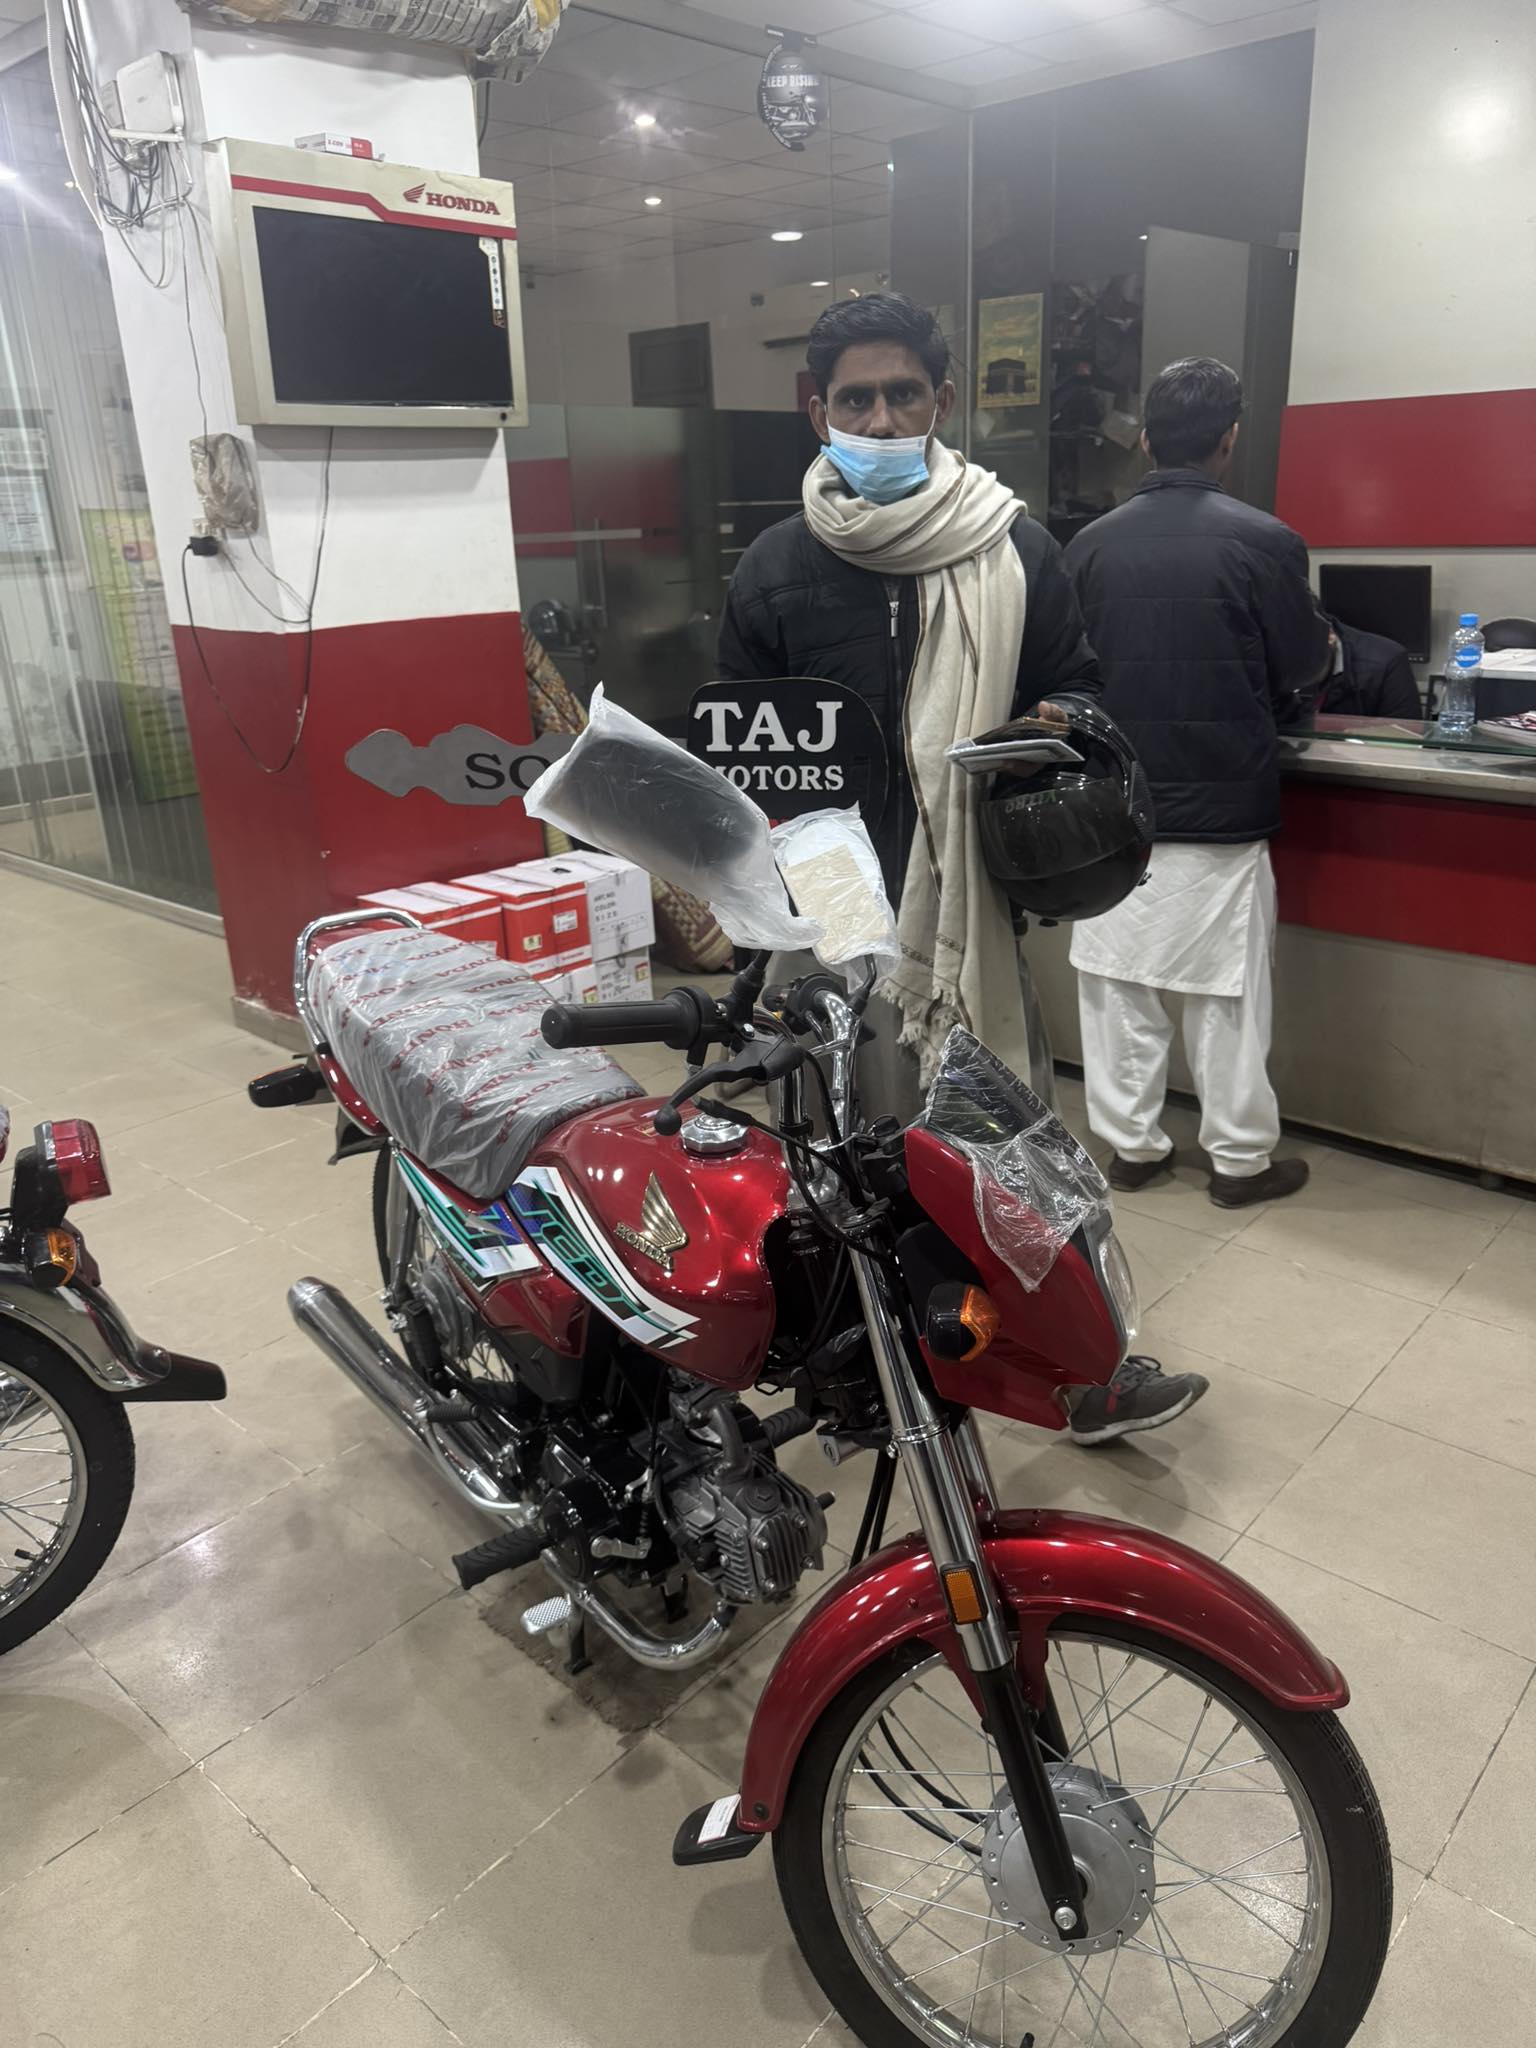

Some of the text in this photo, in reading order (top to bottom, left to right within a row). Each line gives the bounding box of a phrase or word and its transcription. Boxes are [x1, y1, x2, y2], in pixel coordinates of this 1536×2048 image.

[425, 191, 501, 216] HONDA
[693, 701, 843, 752] TAJ
[437, 957, 500, 977] ONDA
[463, 975, 531, 994] ONDA
[613, 1222, 672, 1270] HONDA
